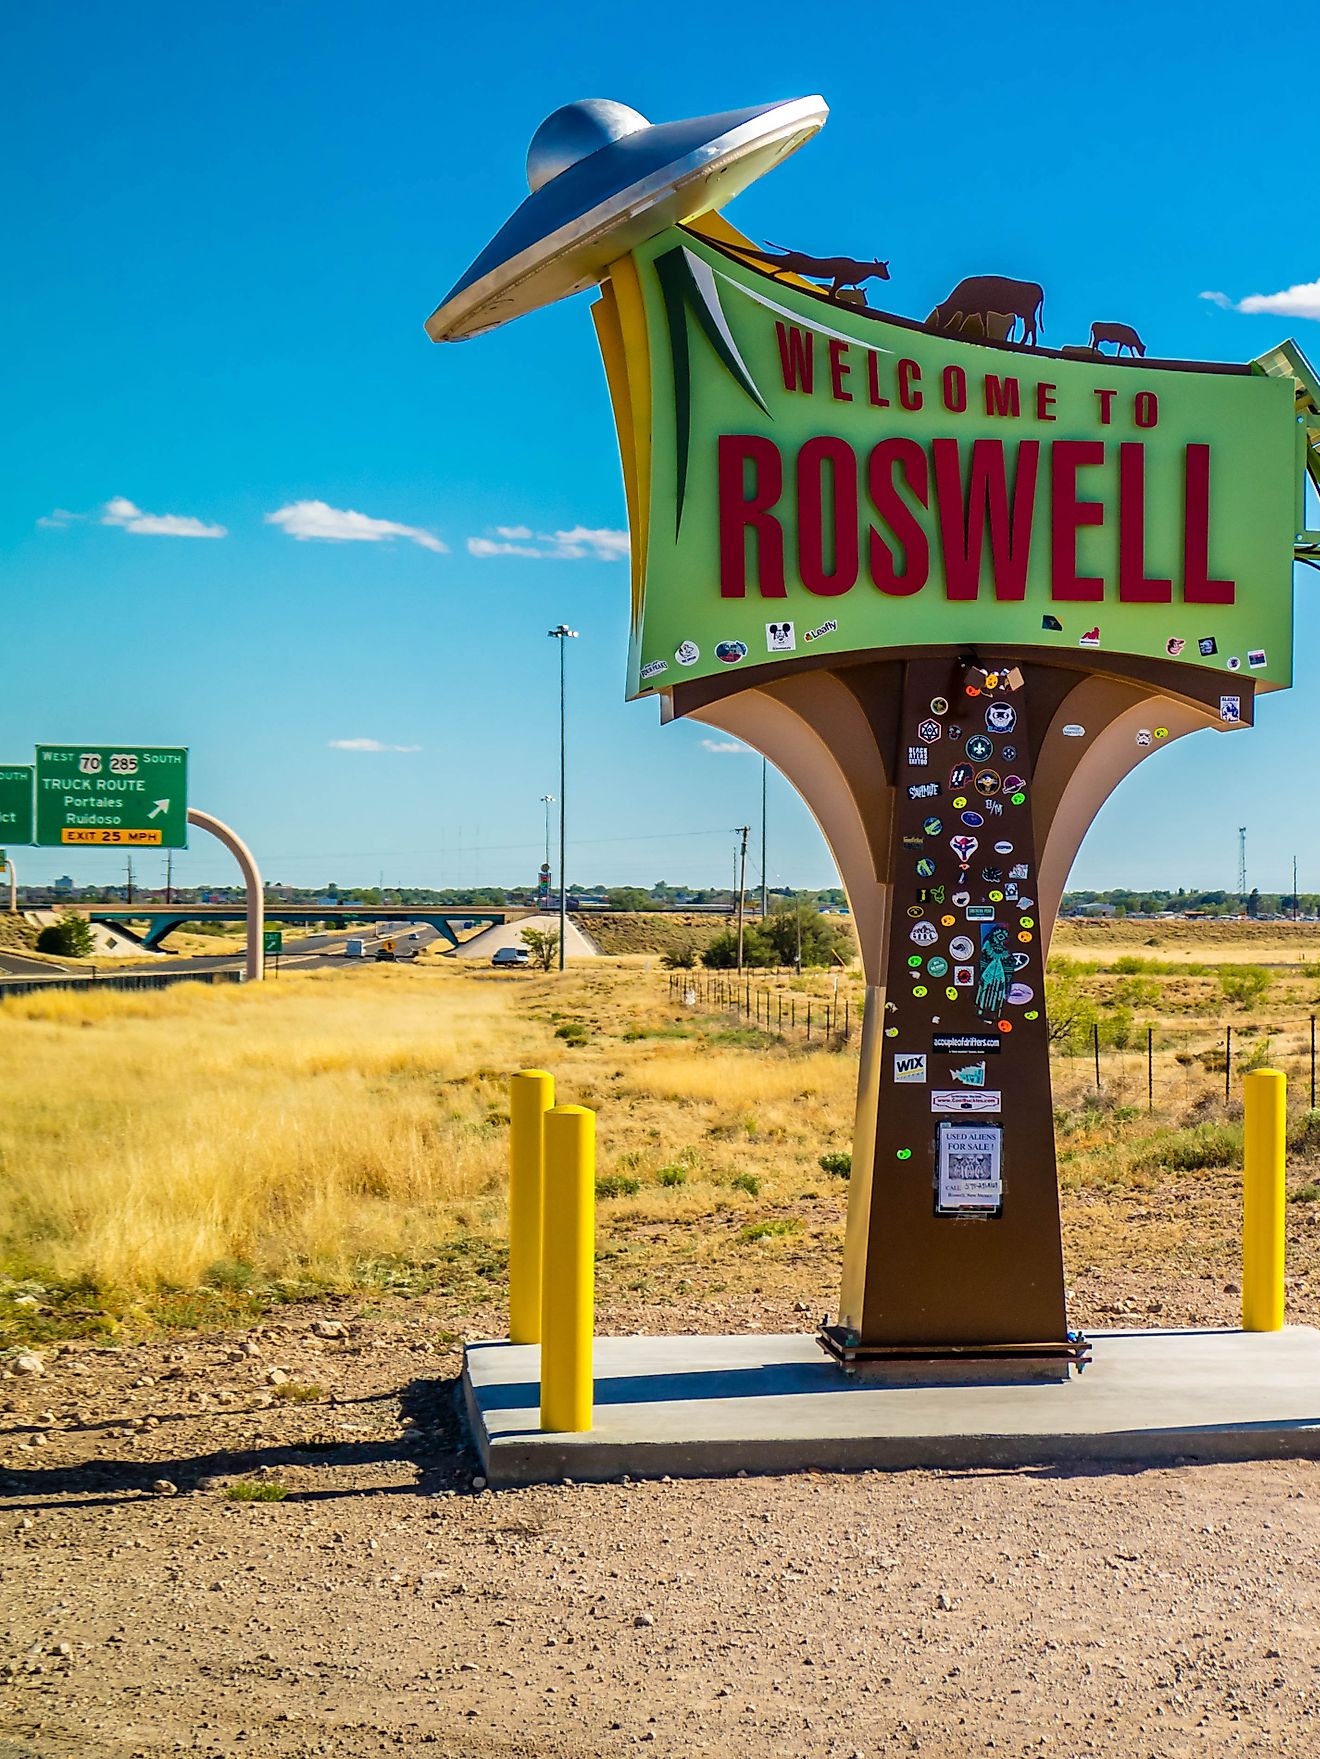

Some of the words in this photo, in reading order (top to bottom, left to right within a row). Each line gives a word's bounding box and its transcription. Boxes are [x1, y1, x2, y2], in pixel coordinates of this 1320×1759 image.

[775, 320, 1057, 421] WELCOME
[1093, 388, 1158, 428] TO
[717, 434, 1235, 605] ROSWELL
[42, 752, 74, 762] WEST
[81, 757, 100, 770] 70
[111, 758, 137, 771] 285
[143, 753, 182, 764] SOUTH
[42, 779, 92, 790] TRUCK
[96, 779, 146, 792] ROUTE
[64, 796, 123, 808] Portales
[66, 813, 122, 825] Ruidoso
[67, 832, 96, 840] EXIT
[102, 832, 121, 842] 25
[128, 833, 157, 841] MPH
[896, 1056, 924, 1073] WIX
[969, 1133, 997, 1141] ALIENS
[948, 1142, 966, 1150] FOR
